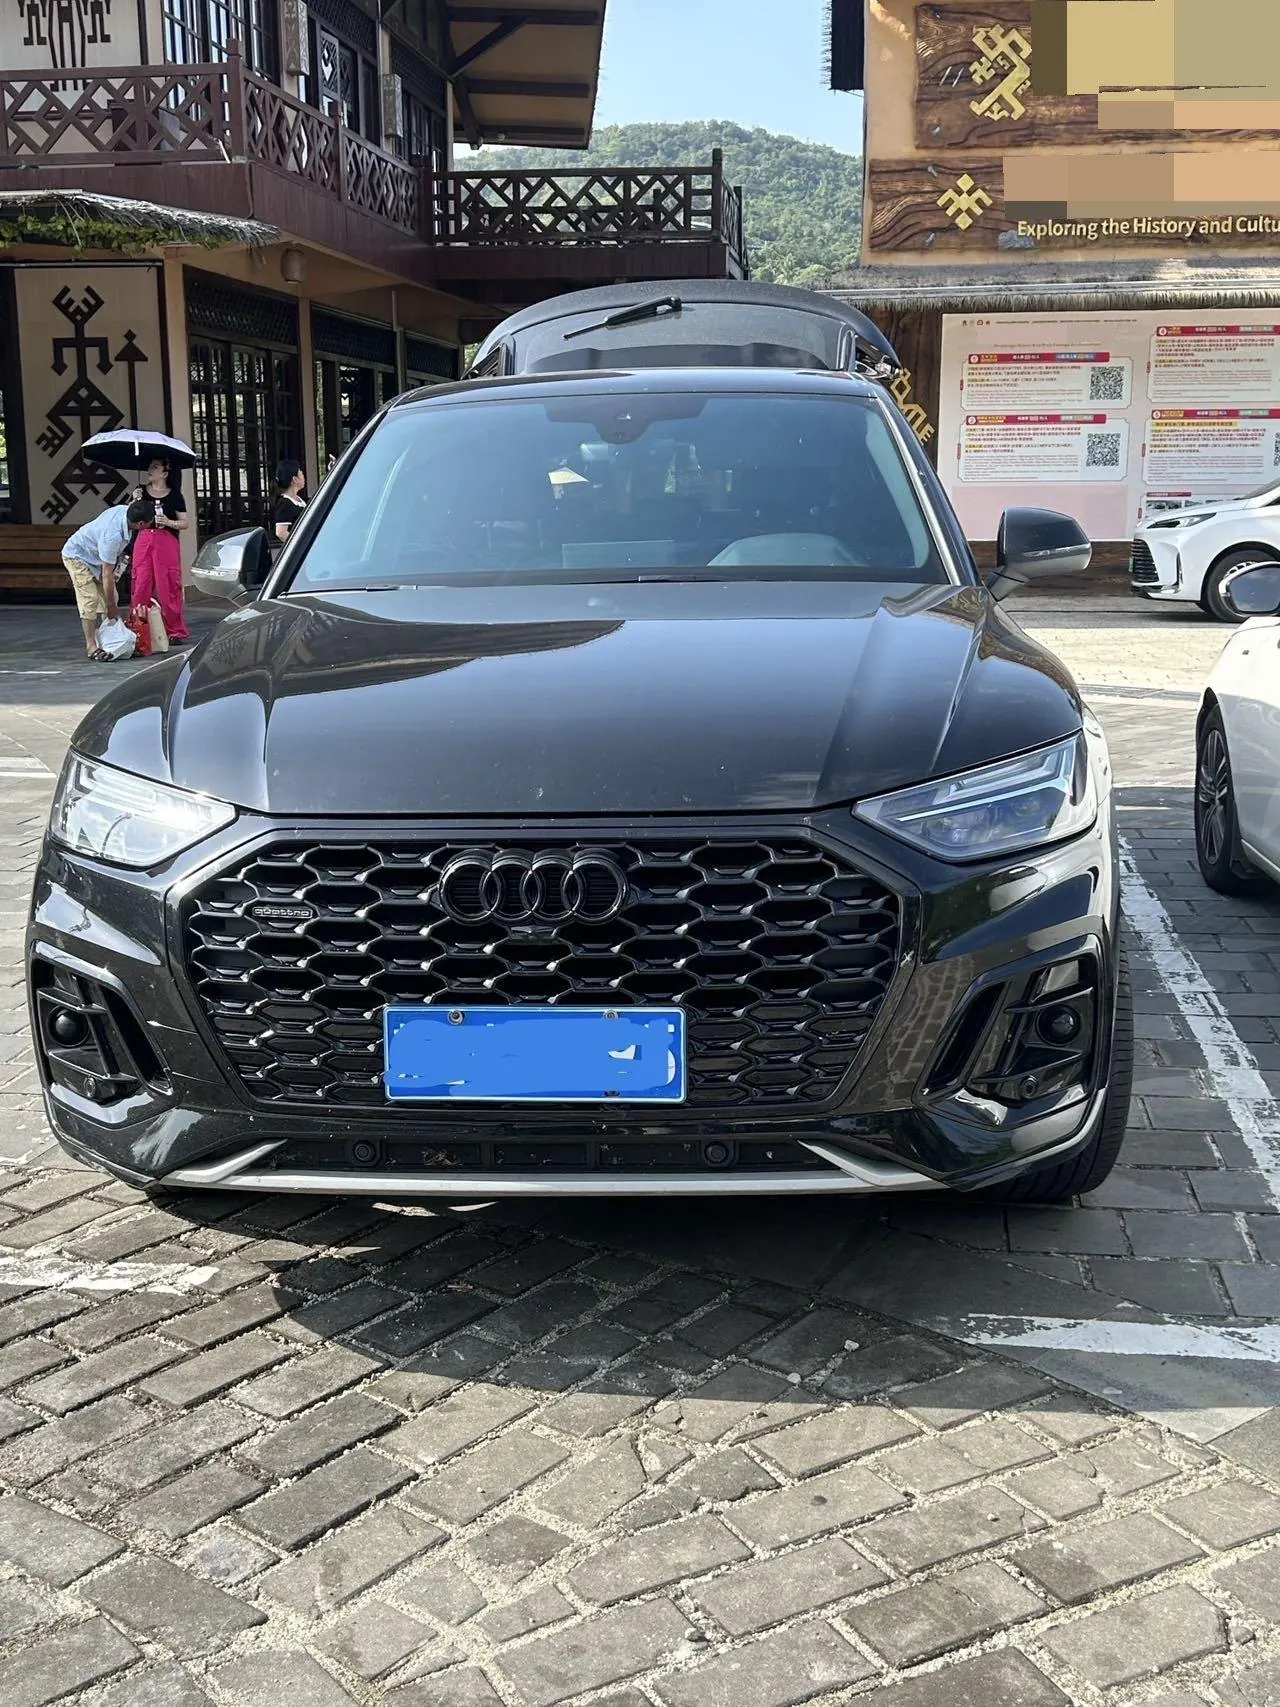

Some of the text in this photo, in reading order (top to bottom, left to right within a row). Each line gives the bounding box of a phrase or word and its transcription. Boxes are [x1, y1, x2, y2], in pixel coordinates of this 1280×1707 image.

[1017, 215, 1280, 241] Exploring the History and Cultu
[254, 908, 310, 917] quattro
